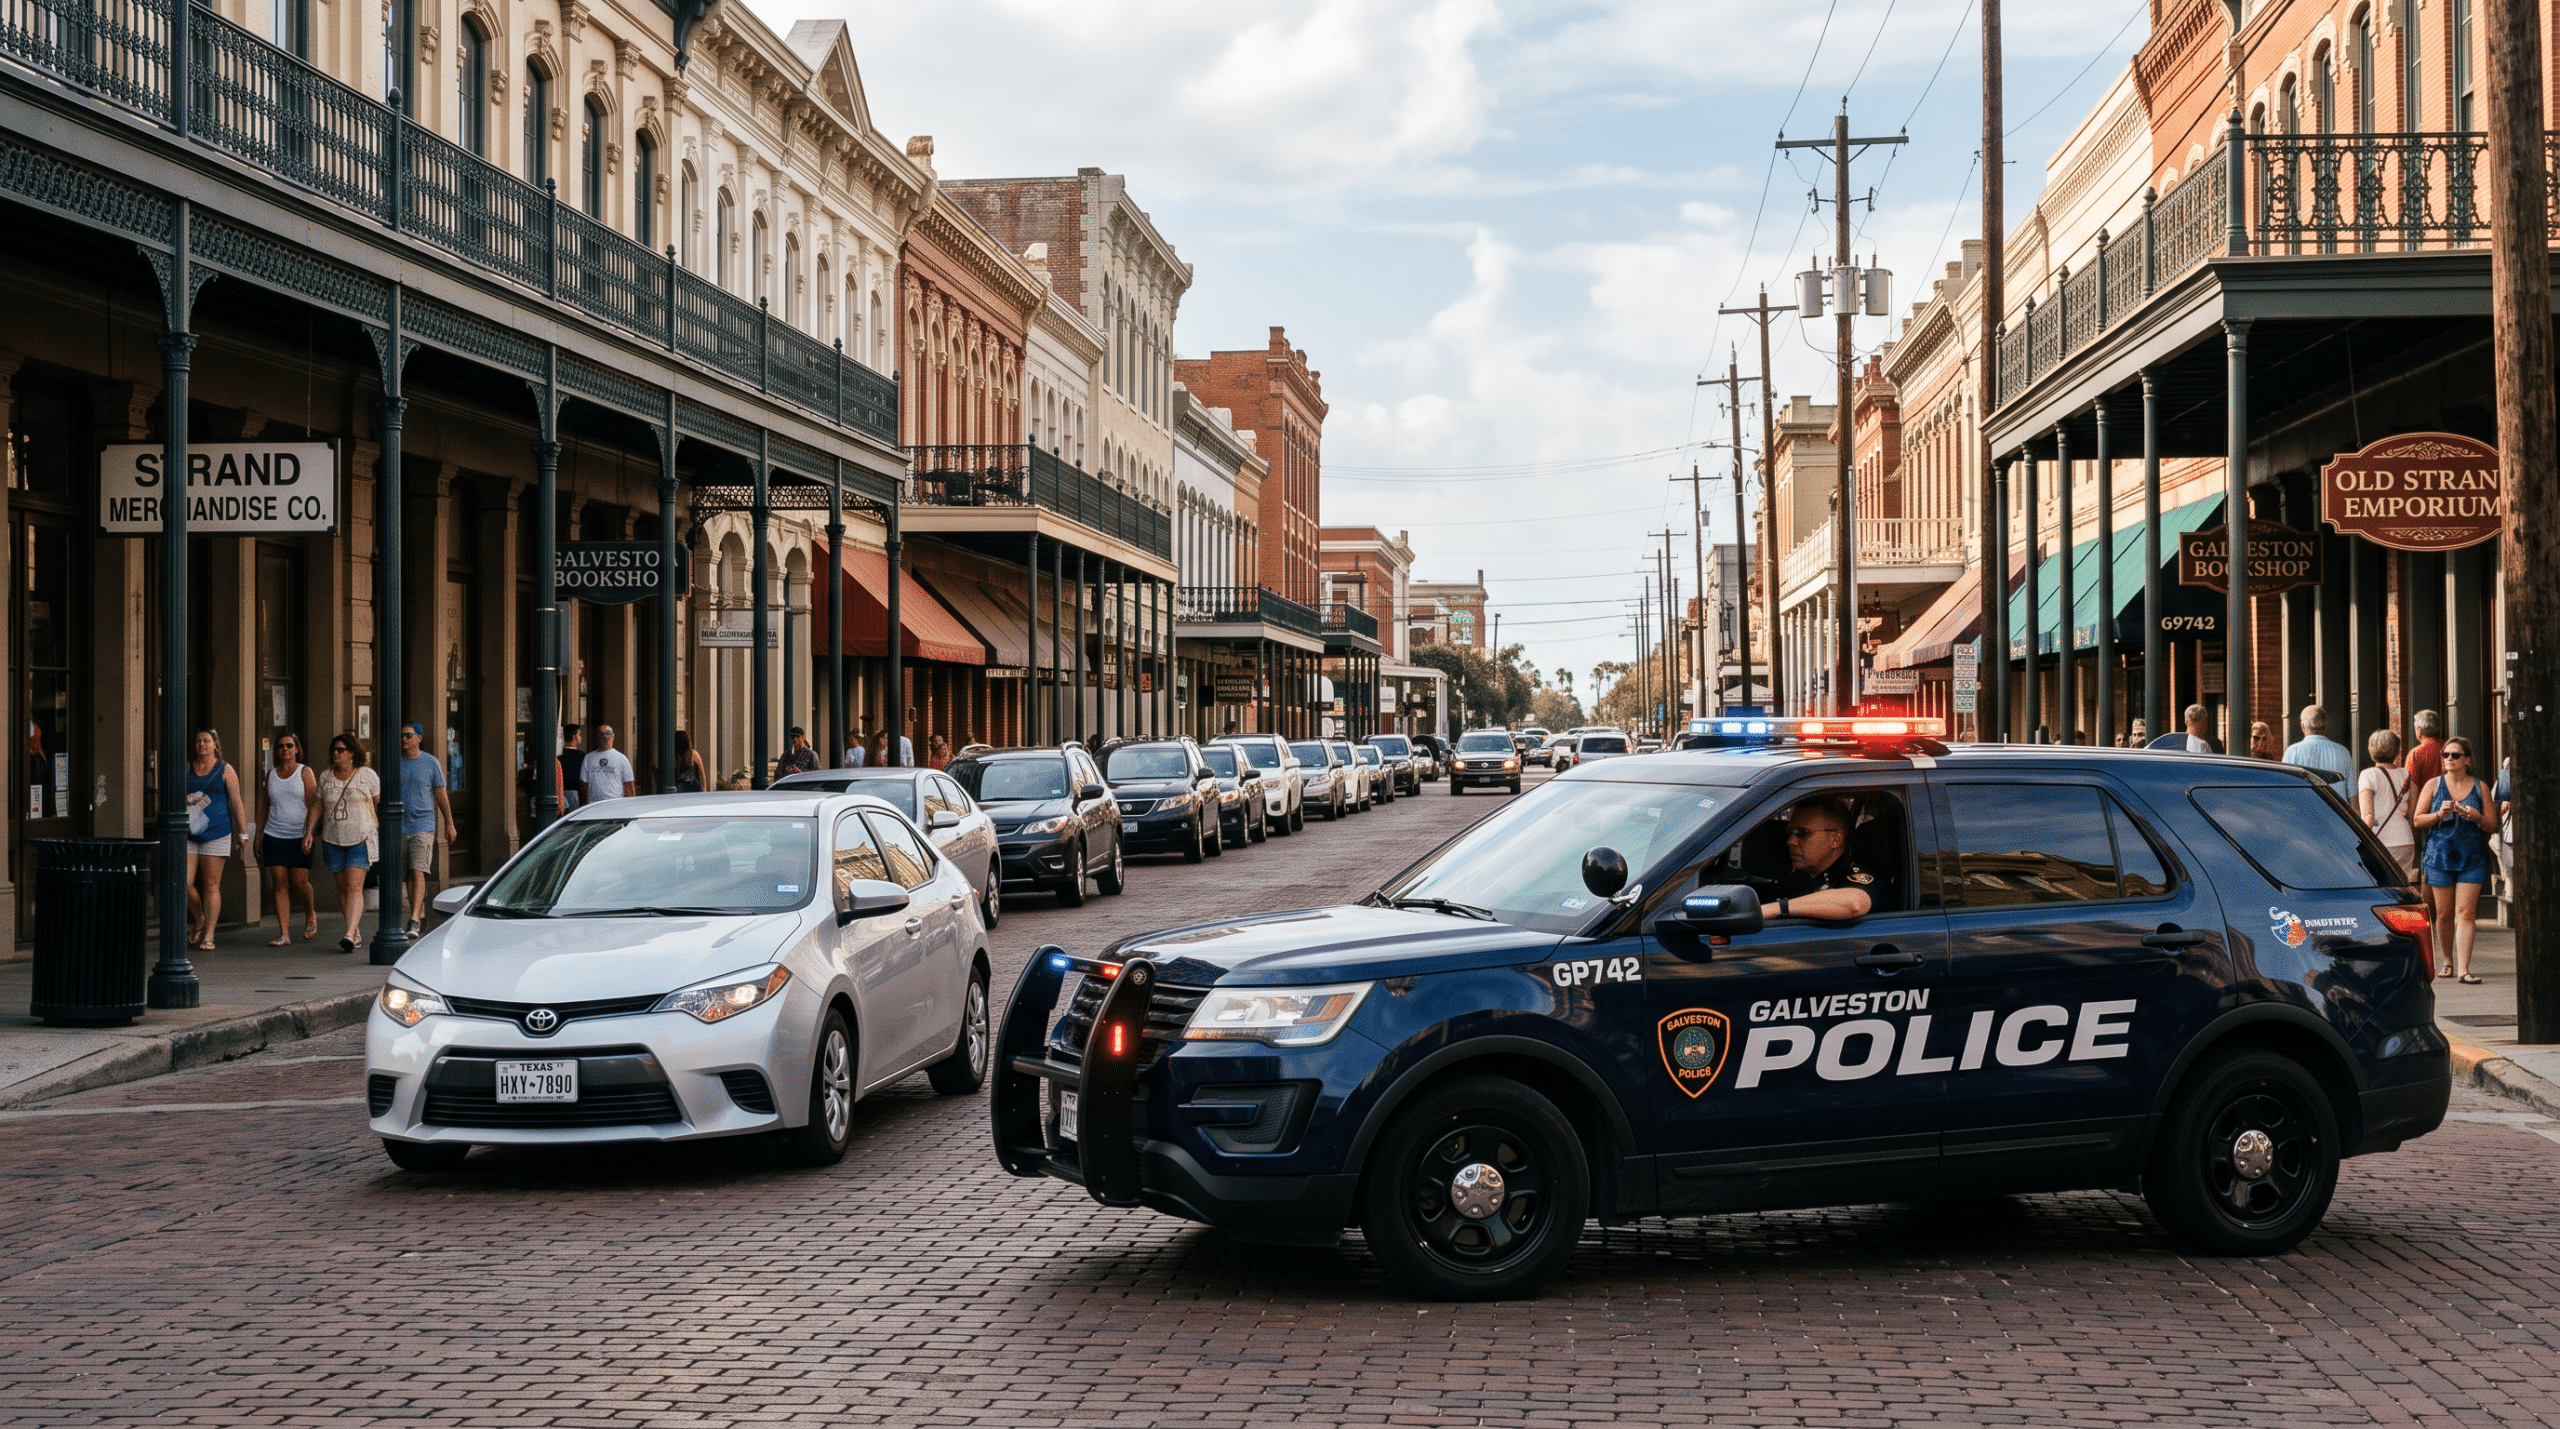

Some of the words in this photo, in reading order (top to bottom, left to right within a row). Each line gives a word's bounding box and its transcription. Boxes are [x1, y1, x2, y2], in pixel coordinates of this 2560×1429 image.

[135, 453, 301, 487] SRAND
[2335, 470, 2394, 491] OLD
[2404, 469, 2499, 491] STRAN
[110, 496, 277, 522] MERANDISE
[287, 496, 326, 521] CO.
[2344, 496, 2502, 518] EMPORIUM
[555, 551, 678, 567] GALVESTO
[2189, 541, 2314, 557] GALESTON
[555, 571, 659, 587] BOOKSHO
[2194, 560, 2310, 577] BOSHOP
[1552, 957, 1642, 987] GP742
[1749, 988, 1930, 1022] GALVESTON
[1667, 1015, 1721, 1031] GALVESTON
[1734, 999, 2137, 1089] POLICE
[520, 1063, 553, 1072] TEXAS
